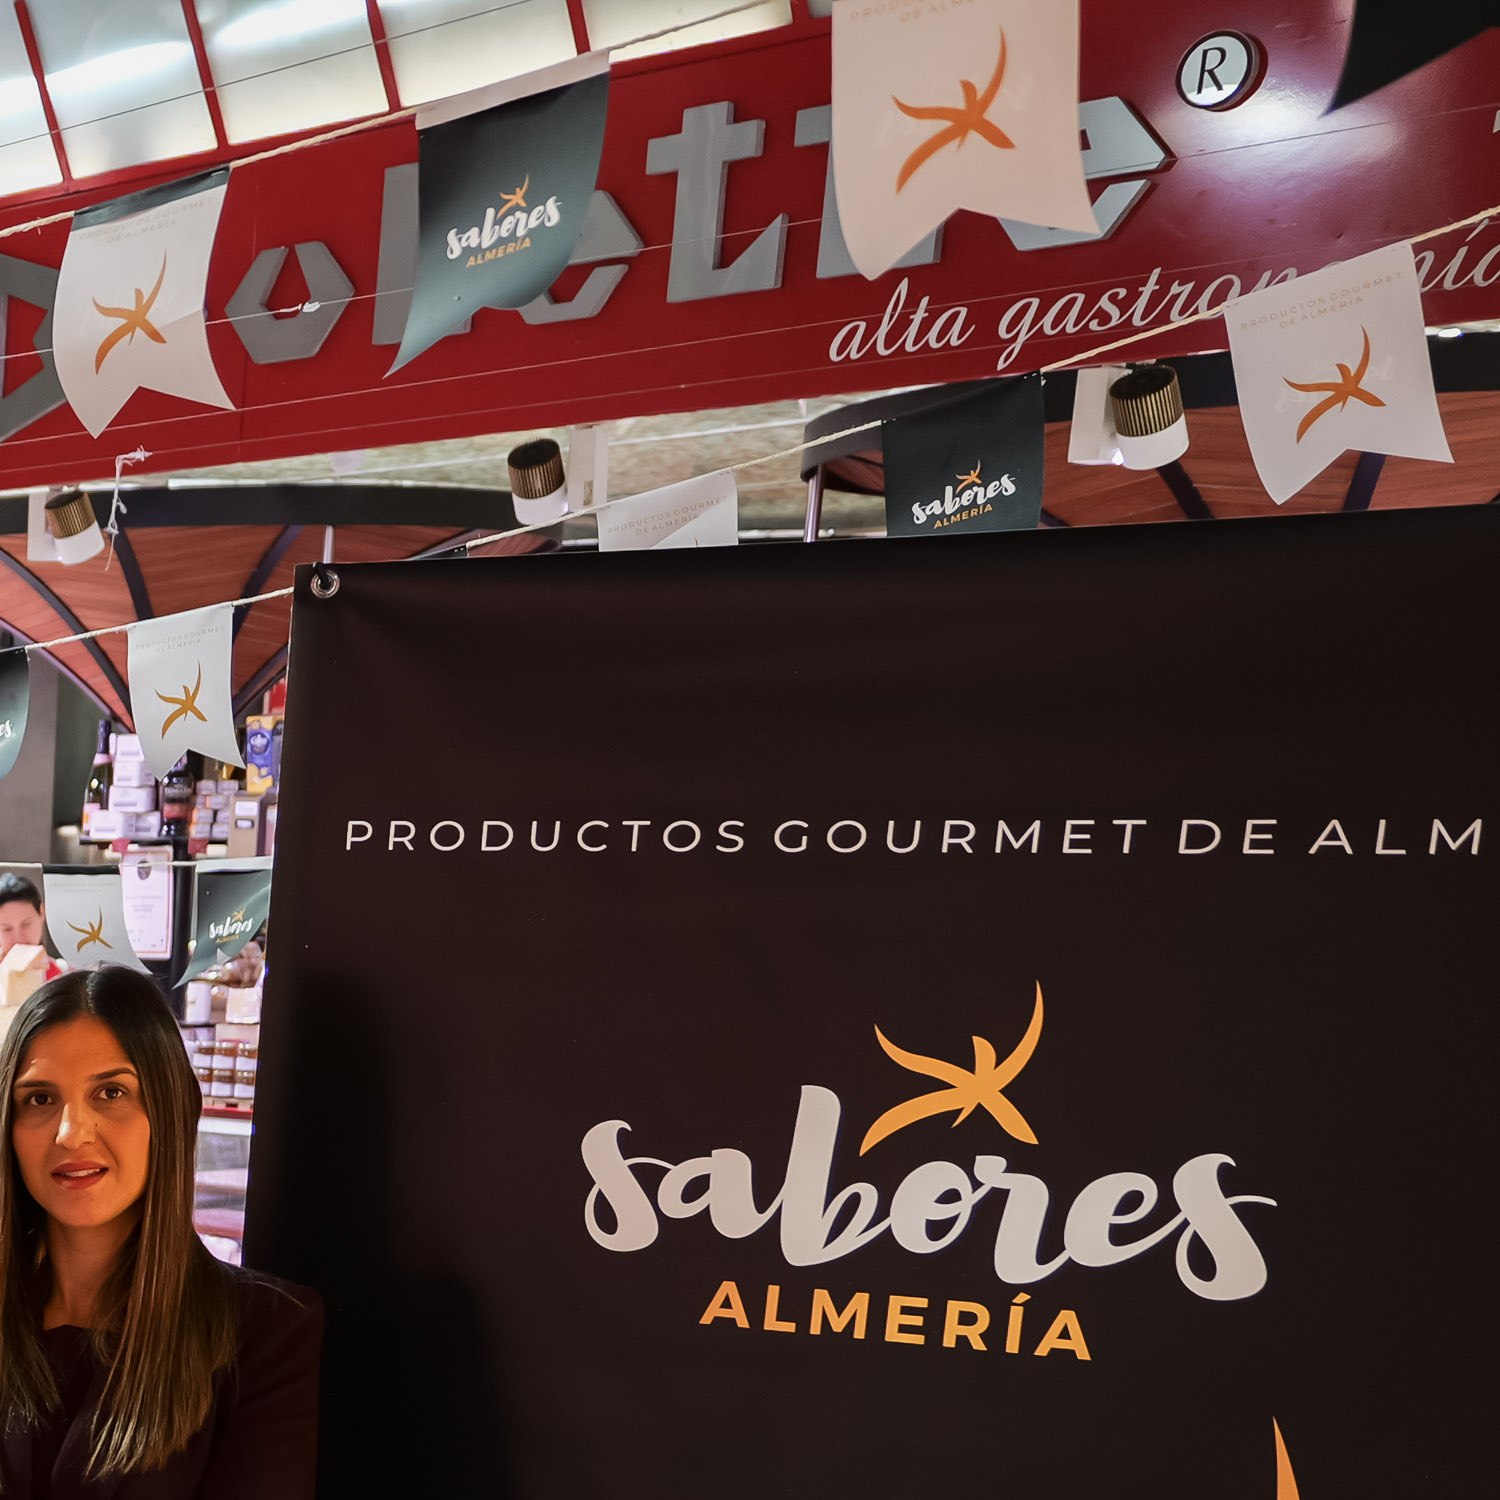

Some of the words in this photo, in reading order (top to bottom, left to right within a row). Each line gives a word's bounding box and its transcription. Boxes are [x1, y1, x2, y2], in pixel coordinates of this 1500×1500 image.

[446, 196, 562, 260] sabores
[465, 236, 532, 268] ALMERÍA
[829, 277, 976, 363] alta
[1240, 297, 1325, 332] PRODUCTOS
[1329, 270, 1405, 302] GOURMET
[1279, 317, 1298, 330] DE
[1300, 295, 1364, 322] ALMERÍA
[911, 473, 1017, 524] sabores
[933, 503, 994, 530] ALMERÍA
[344, 818, 748, 853] PRODUCTOS
[773, 817, 1150, 855] GOURMET
[1178, 817, 1277, 856] DE
[580, 1084, 1279, 1302] sabores
[697, 1279, 1094, 1361] ALMERÍA
